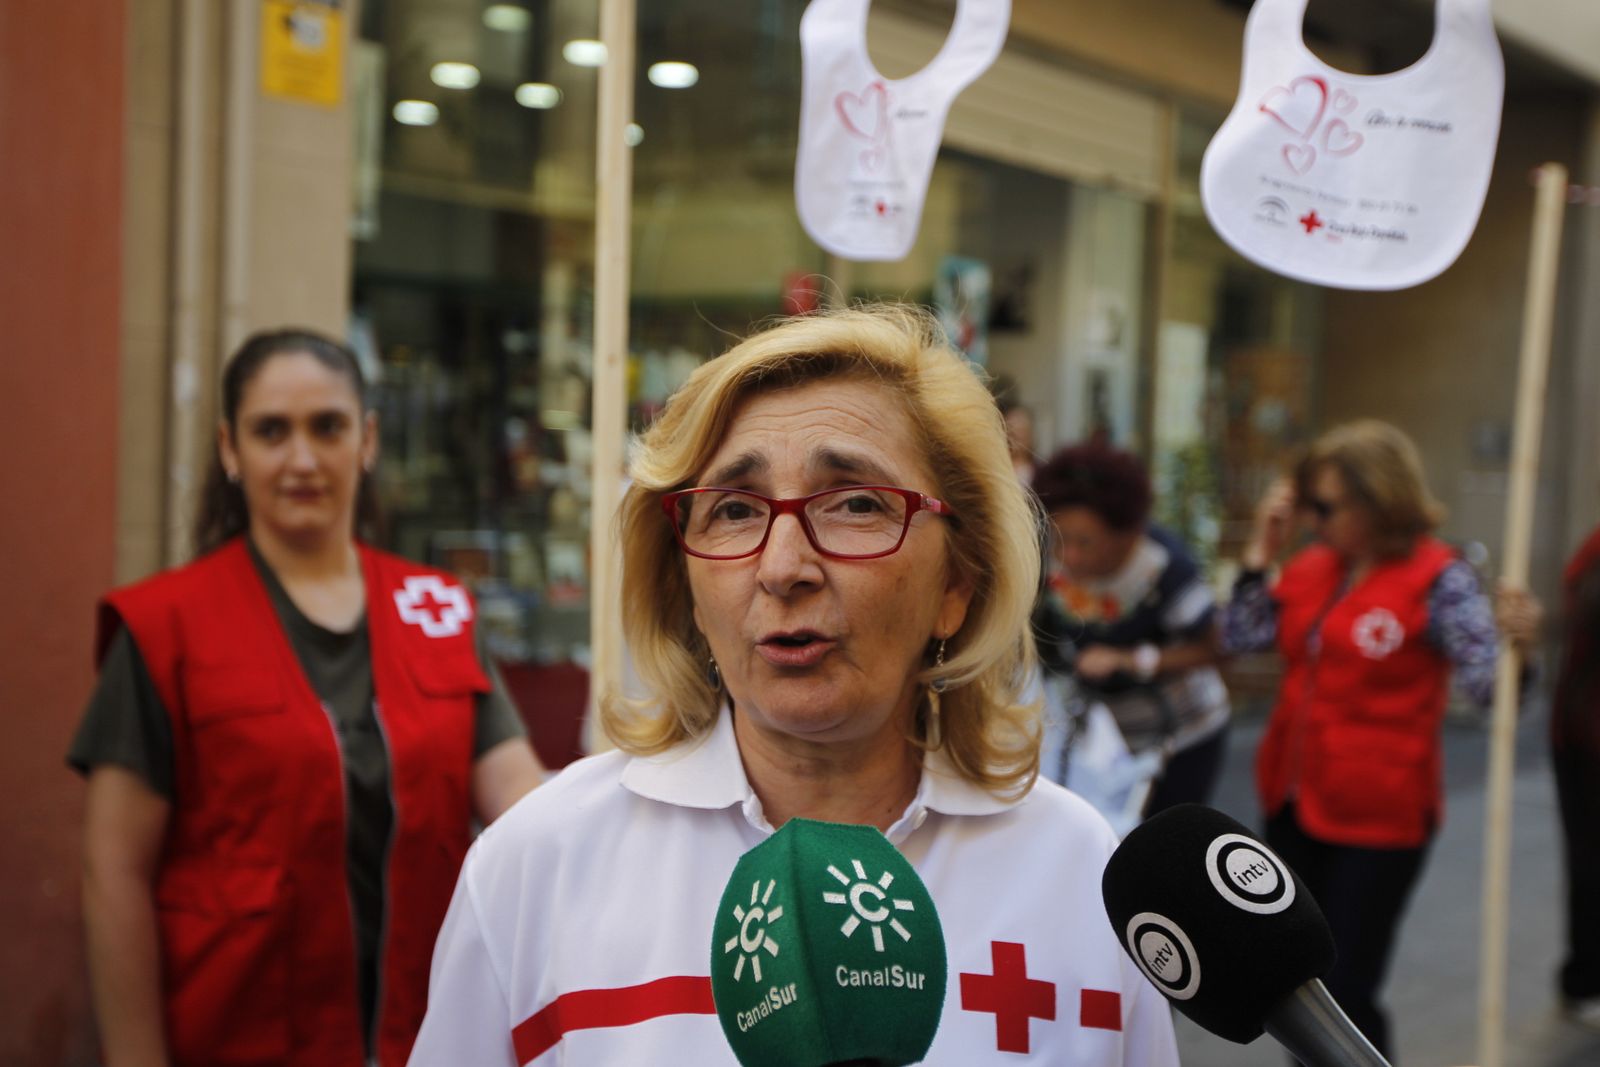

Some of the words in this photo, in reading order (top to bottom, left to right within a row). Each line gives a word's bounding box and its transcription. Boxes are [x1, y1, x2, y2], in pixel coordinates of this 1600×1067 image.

[1233, 861, 1269, 886] intv
[1149, 943, 1173, 974] intv
[836, 965, 926, 990] CanalSur
[737, 983, 797, 1033] CanalSur
